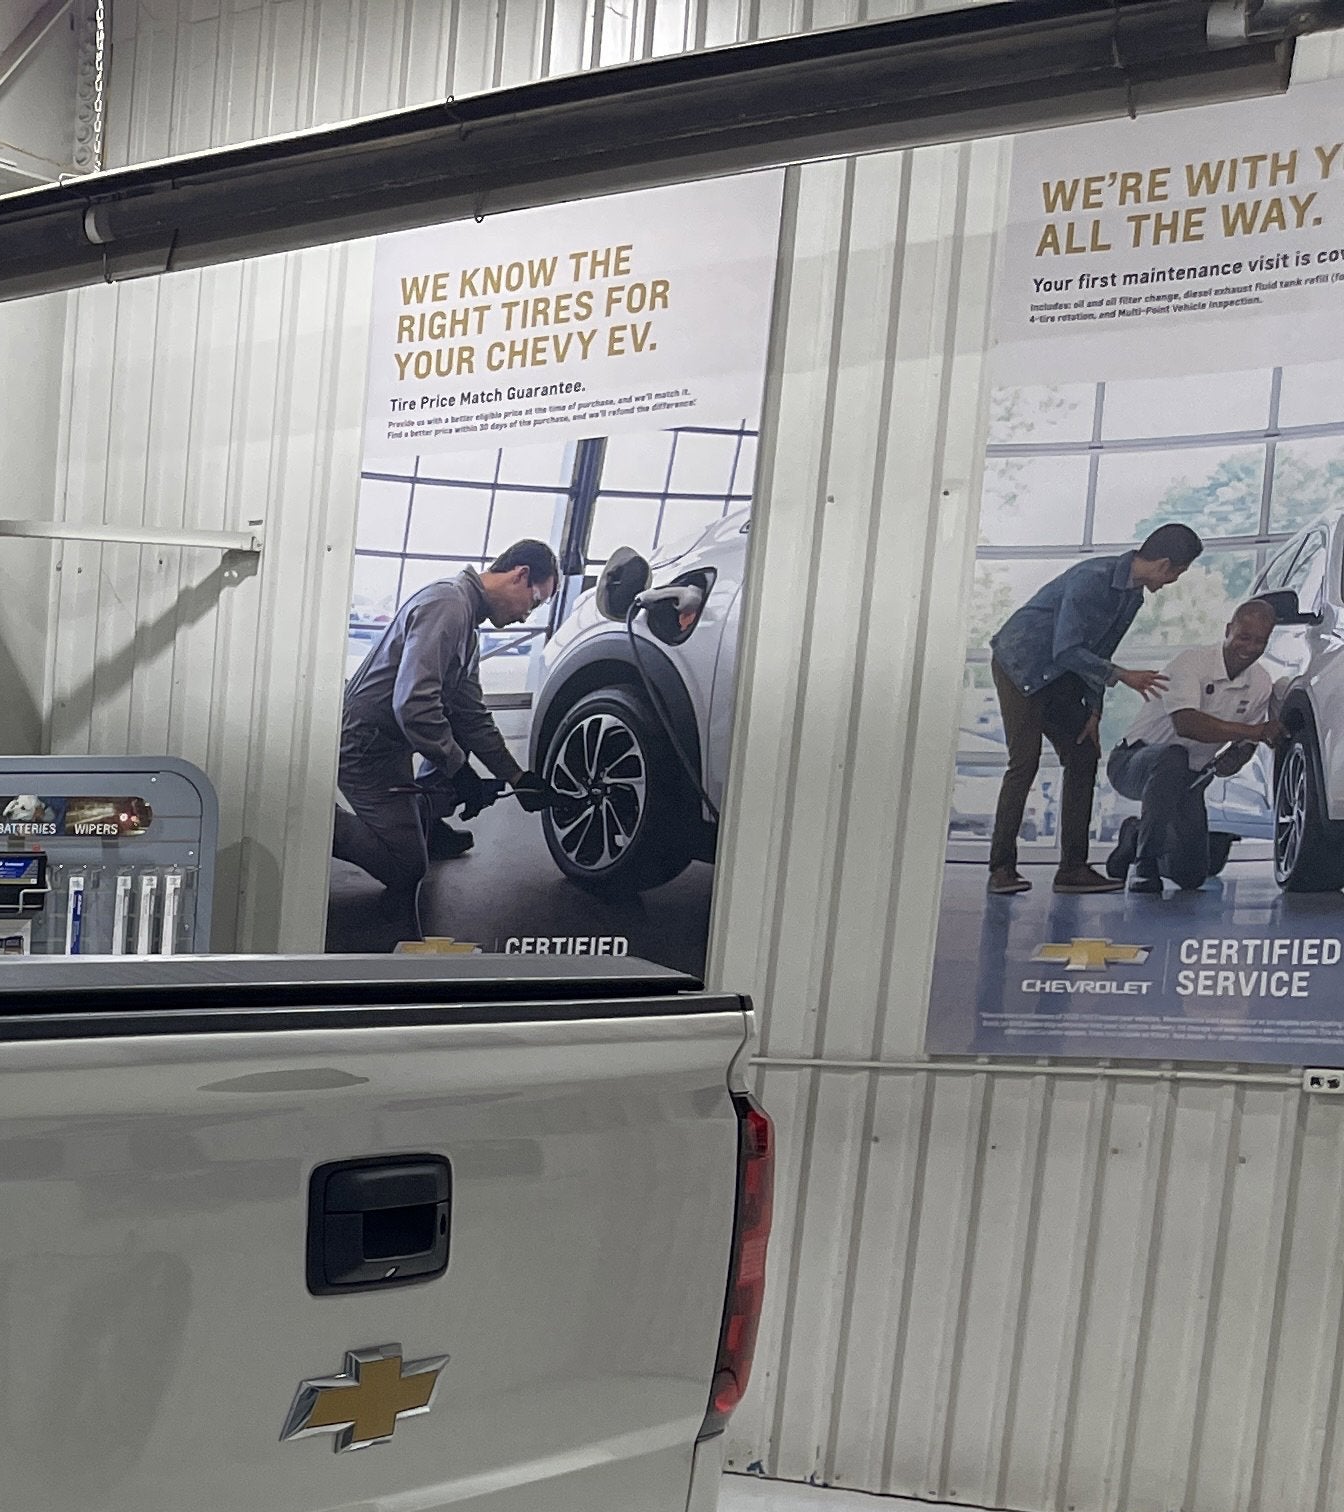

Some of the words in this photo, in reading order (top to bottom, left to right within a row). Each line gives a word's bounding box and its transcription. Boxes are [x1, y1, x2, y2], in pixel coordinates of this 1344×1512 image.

[1042, 167, 1171, 213] WE'RE
[1185, 149, 1298, 197] WITH
[1314, 143, 1344, 180] Y
[1035, 219, 1111, 257] ALL
[1126, 206, 1207, 248] THE
[1221, 191, 1323, 237] WAY.
[401, 272, 450, 306] WE
[459, 256, 558, 298] KNOW
[568, 244, 633, 281] THE
[1033, 277, 1073, 293] Your
[1078, 273, 1117, 289] first
[1122, 261, 1243, 286] maintenance
[1248, 253, 1289, 272] visit
[1295, 250, 1311, 267] is
[1073, 300, 1085, 309] oil
[1087, 299, 1104, 308] and
[1105, 298, 1117, 306] oil
[1119, 295, 1143, 305] filter
[1184, 289, 1212, 299] diesel
[1214, 284, 1253, 296] exhaust
[1254, 281, 1278, 292] fluid
[1279, 278, 1303, 288] tank
[1304, 274, 1329, 285] refill
[396, 304, 492, 344] RIGHT
[500, 290, 593, 332] TIRES
[604, 279, 670, 318] FOR
[1099, 310, 1116, 319] and
[1173, 301, 1207, 313] Vehicle
[394, 345, 474, 381] YOUR
[486, 329, 597, 372] CHEVY
[606, 321, 658, 357] EV.
[388, 420, 415, 428] Provide
[427, 417, 443, 425] with
[450, 415, 474, 423] better
[475, 412, 502, 422] eligible
[503, 410, 523, 420] price
[549, 404, 566, 412] time
[568, 402, 576, 411] of
[618, 395, 633, 404] and
[654, 390, 680, 399] match
[390, 397, 416, 411] Tire
[420, 394, 456, 410] Price
[460, 388, 502, 406] Match
[507, 382, 585, 400] Guarantee.
[387, 431, 403, 439] Find
[410, 429, 432, 437] better
[434, 428, 453, 437] price
[454, 425, 478, 433] within
[490, 421, 507, 431] days
[509, 419, 517, 428] of
[519, 419, 531, 427] the
[572, 412, 586, 421] and
[608, 407, 635, 416] refund
[637, 405, 650, 413] the
[74, 823, 119, 835] WIPERS
[505, 936, 629, 957] CERTIFIED
[1179, 938, 1343, 965] CERTIFIED
[1020, 979, 1153, 995] CHEVROLET
[1175, 970, 1311, 997] SERVICE
